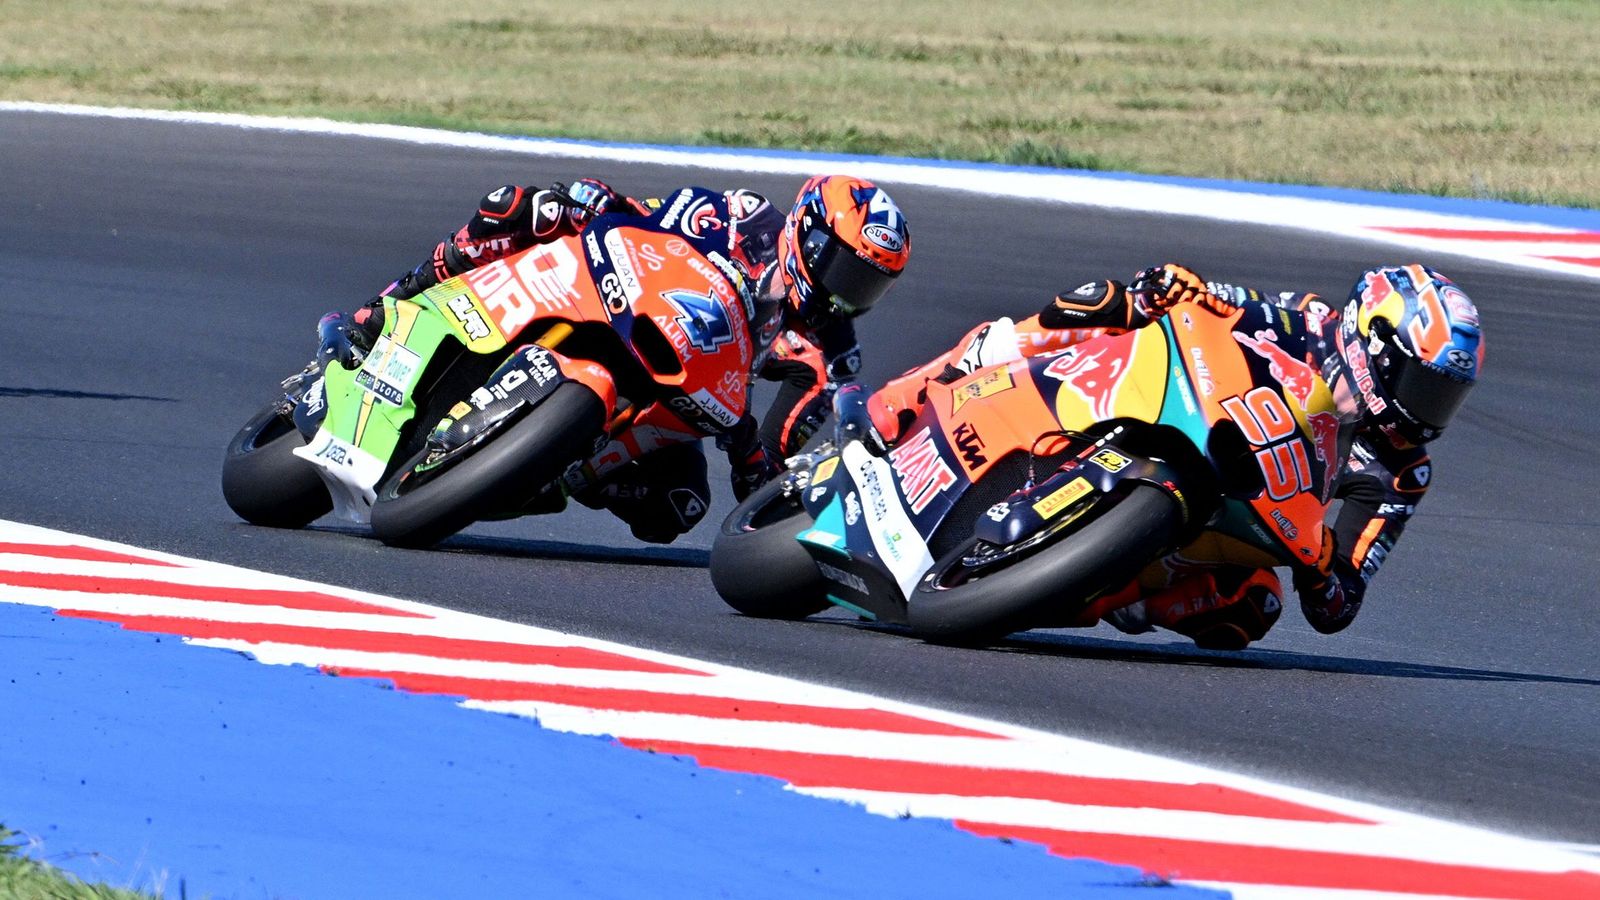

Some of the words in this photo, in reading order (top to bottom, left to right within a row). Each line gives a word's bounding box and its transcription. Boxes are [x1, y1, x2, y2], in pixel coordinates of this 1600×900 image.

[868, 226, 903, 250] SUOMY
[659, 287, 736, 355] 4
[528, 367, 547, 387] LEGAL
[1346, 340, 1370, 383] Red
[1358, 374, 1388, 416] Bull
[888, 426, 957, 516] AVANT
[952, 422, 988, 472] KTM
[1219, 386, 1313, 501] 95
[1040, 482, 1084, 513] PIRELLI
